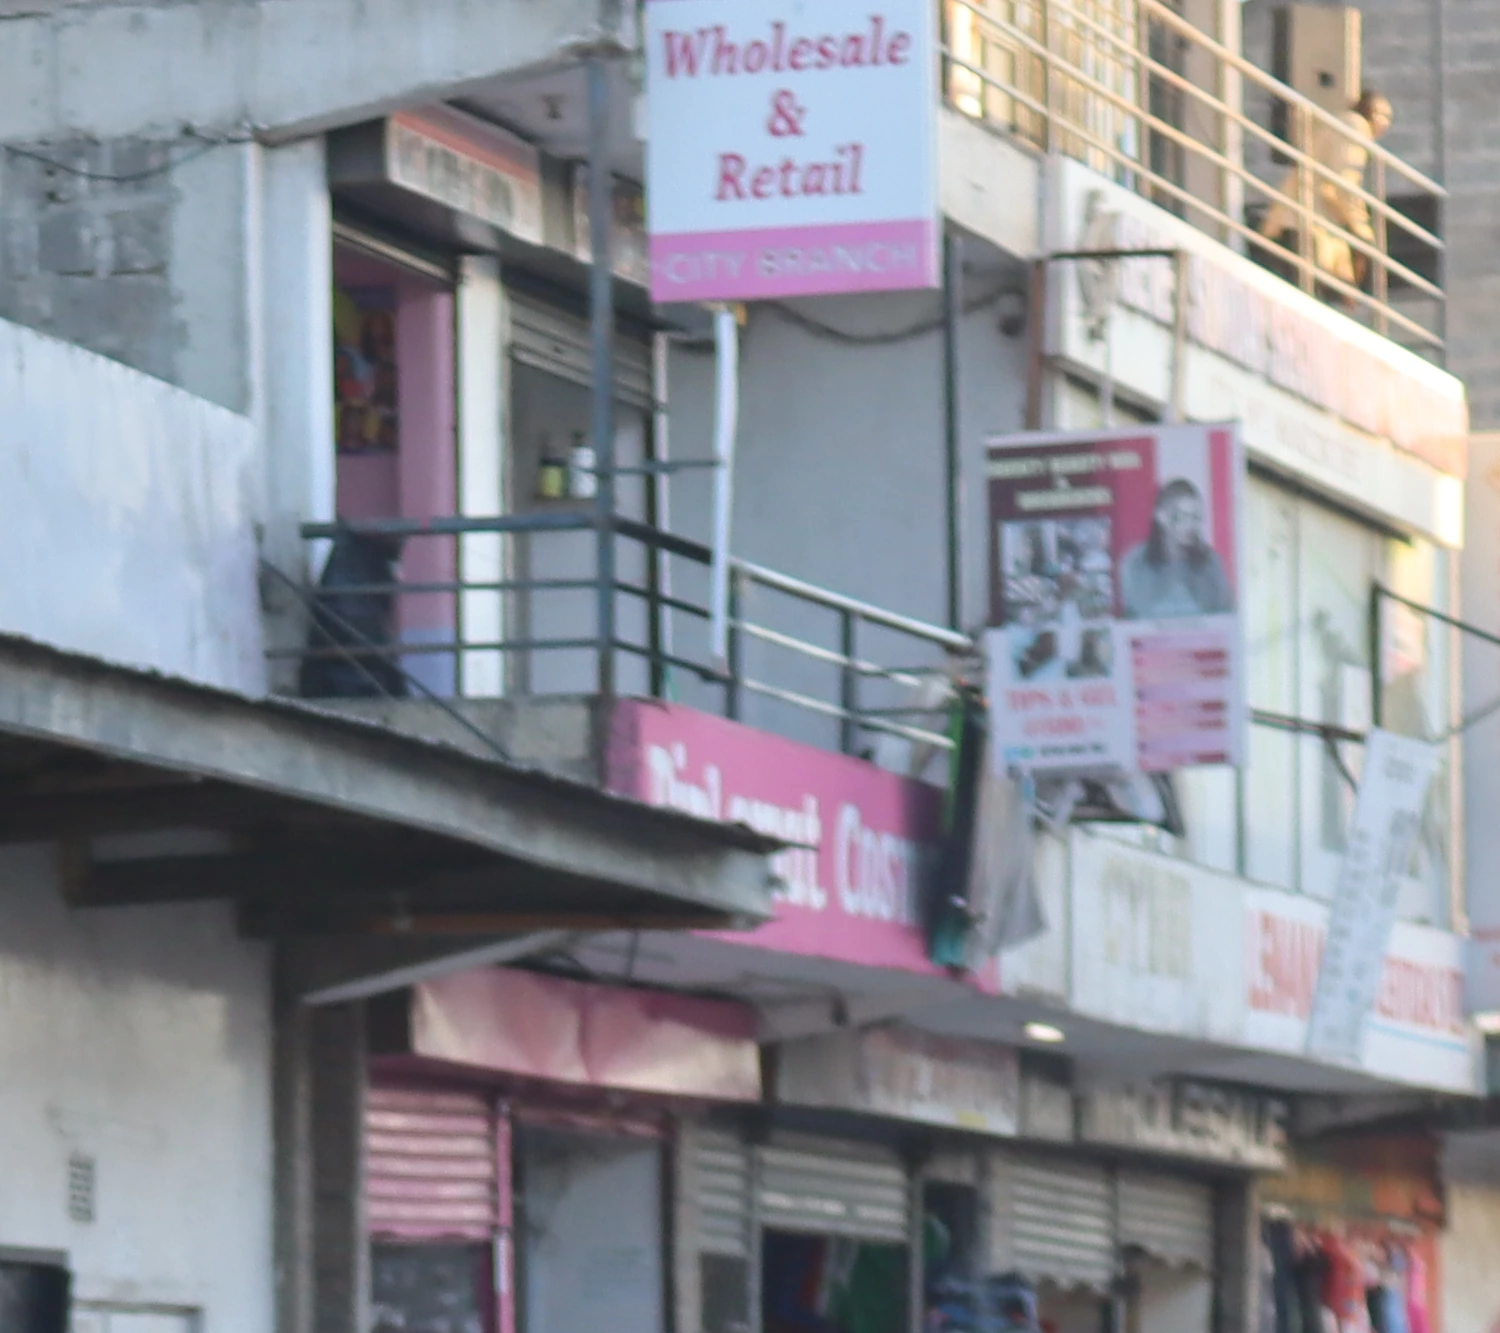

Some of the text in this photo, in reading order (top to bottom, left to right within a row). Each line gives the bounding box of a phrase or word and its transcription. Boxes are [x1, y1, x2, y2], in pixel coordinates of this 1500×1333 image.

[662, 15, 912, 79] Wholesale
[766, 89, 807, 138] &
[715, 143, 865, 201] Retail
